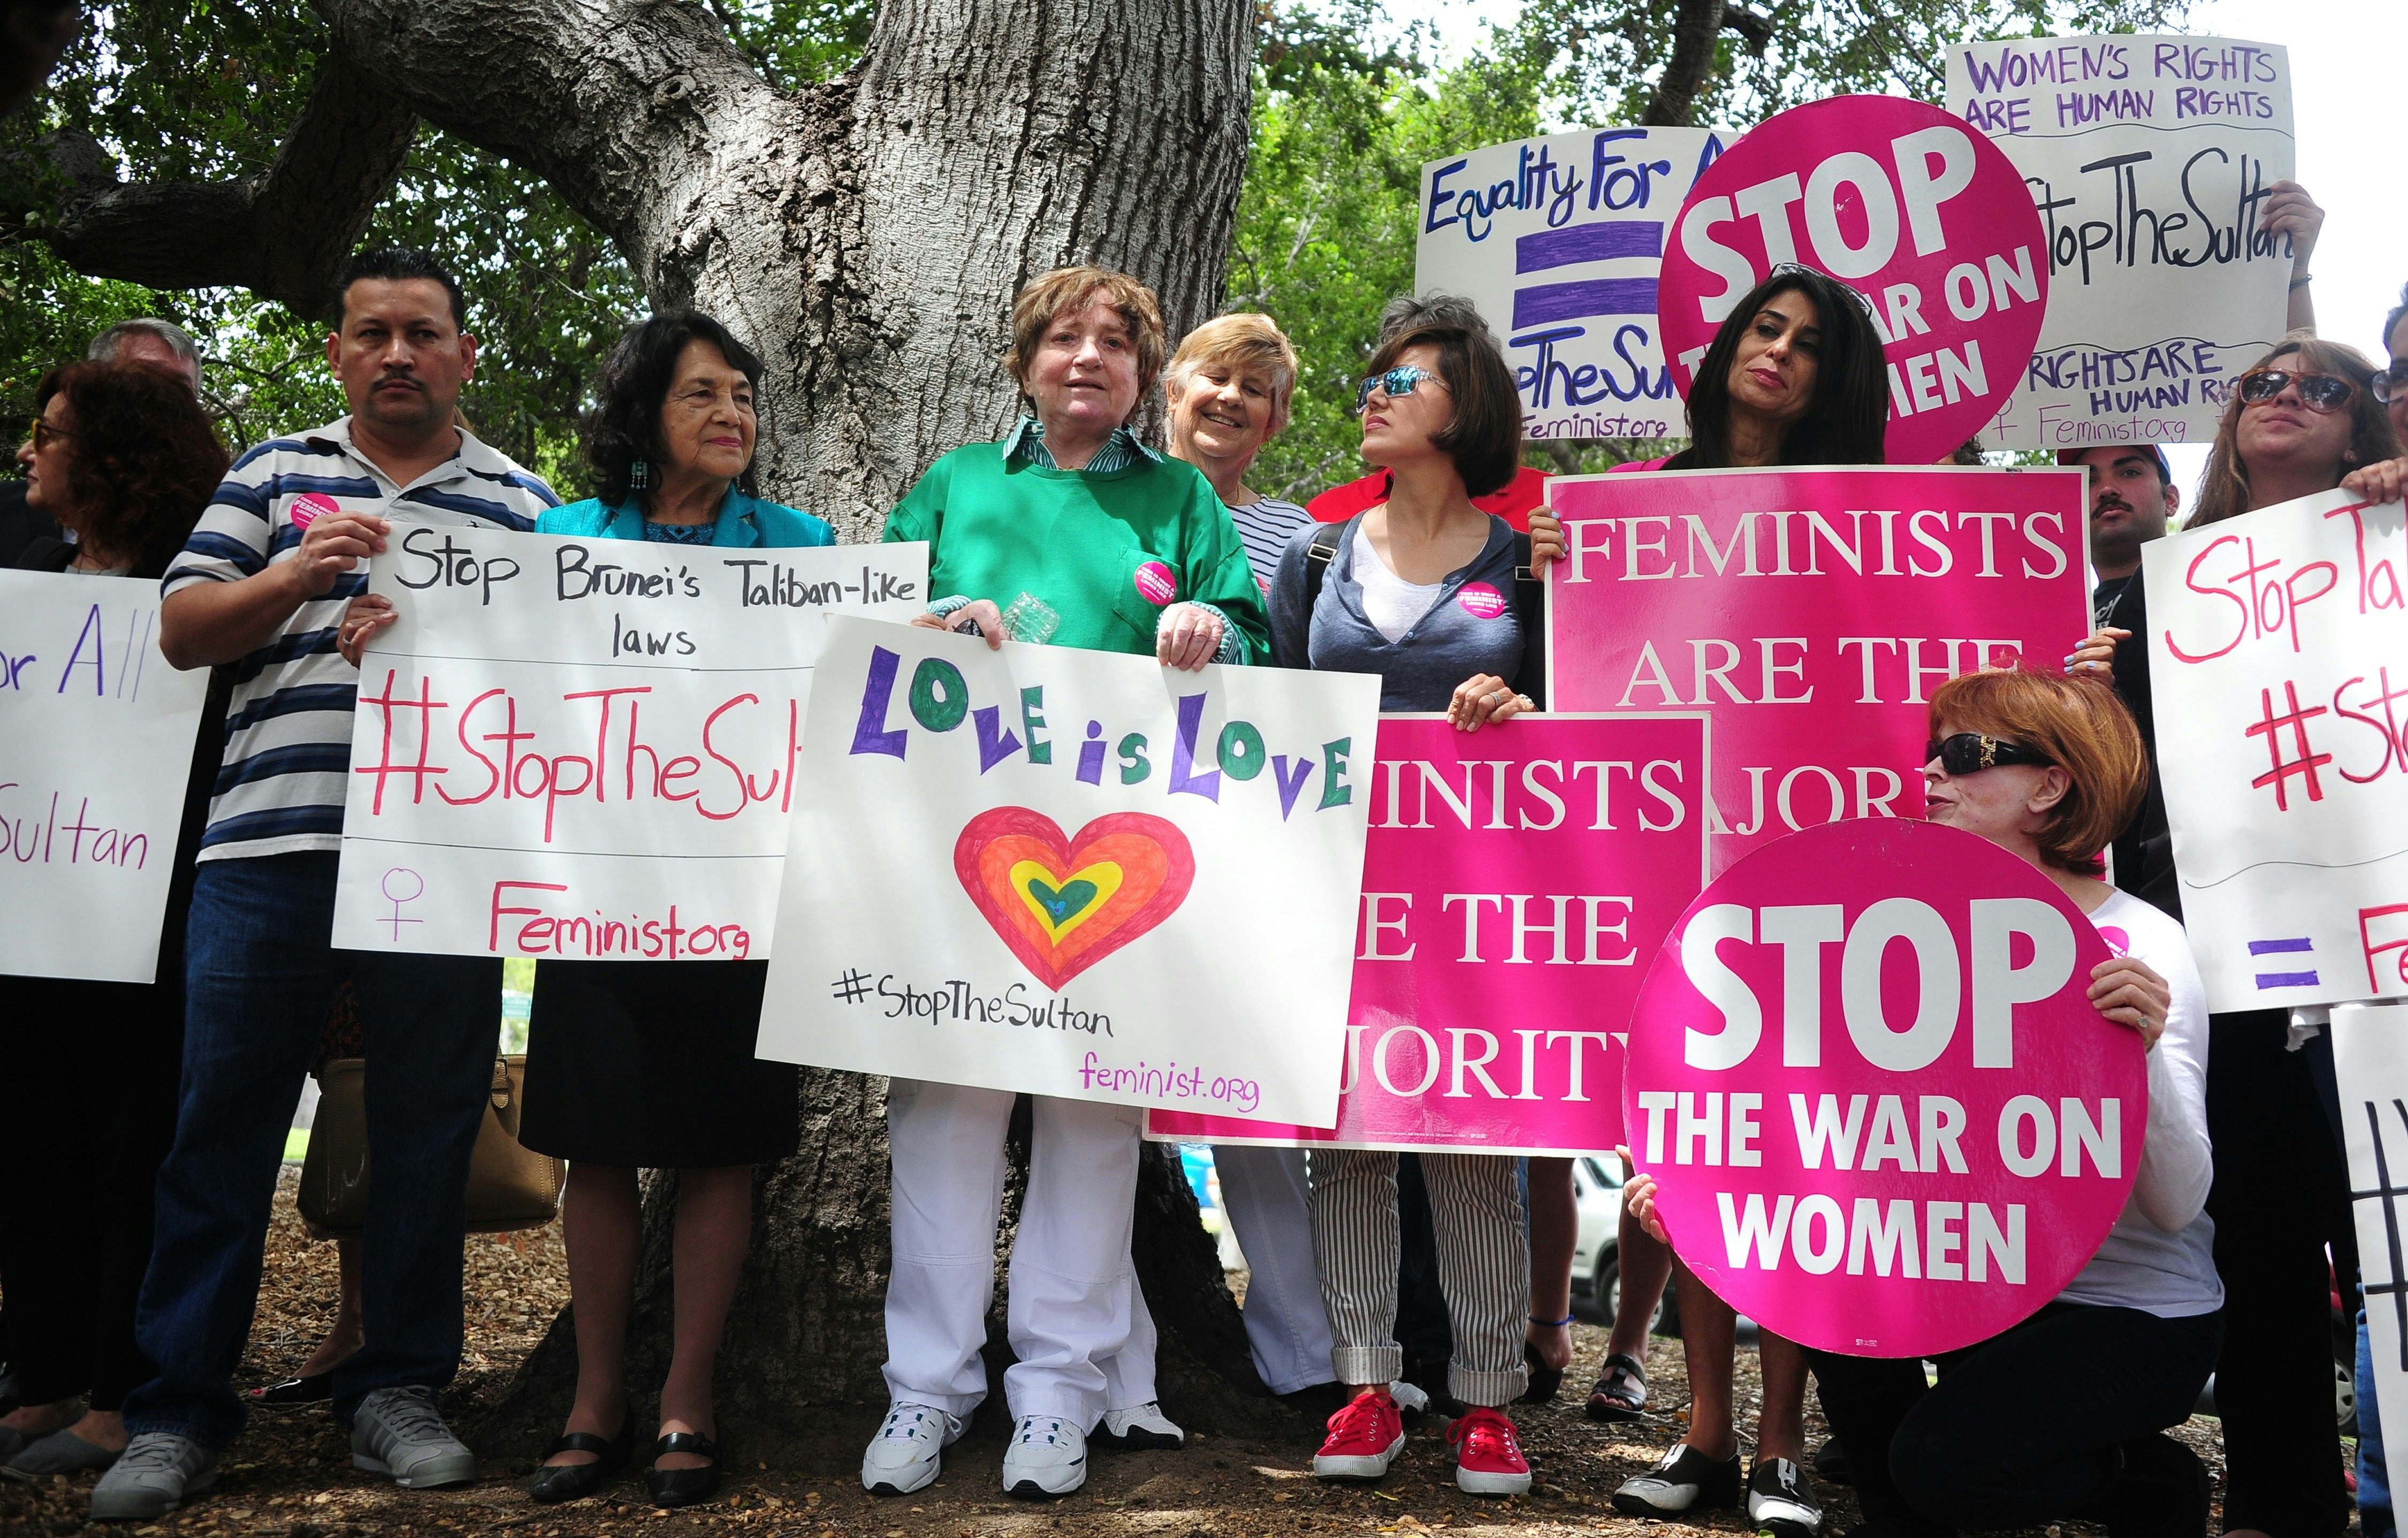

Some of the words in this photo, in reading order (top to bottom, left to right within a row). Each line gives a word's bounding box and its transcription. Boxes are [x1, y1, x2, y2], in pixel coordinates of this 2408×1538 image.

[1964, 43, 2129, 94] WOMEN'S
[2154, 43, 2276, 83] RIGHTS
[1965, 98, 2030, 133] ARE
[2056, 89, 2154, 128] HUMAN
[2176, 86, 2273, 119] RIGHTS
[1424, 143, 1584, 242] Equality
[1588, 128, 1671, 211] For
[1681, 126, 1976, 323] STOP
[1945, 245, 2040, 322] ON
[2028, 351, 2139, 391] RIGHTS
[2140, 341, 2223, 380] ARE
[2090, 378, 2190, 416] HUMAN
[2038, 404, 2186, 444] Feminist.org
[394, 528, 521, 606] Stop
[556, 545, 701, 602] Brunei's
[723, 557, 916, 607] Taliban-like
[1563, 509, 2068, 583] FEMINISTS
[1137, 569, 1175, 599] FEMINIST
[1458, 595, 1503, 606] FEMINIST
[2165, 535, 2338, 664] Stop
[58, 603, 155, 703] All
[613, 613, 697, 658] laws
[1615, 637, 1815, 707] ARE
[355, 668, 803, 843] #StopTheSul
[849, 644, 1053, 775] LOVE
[1075, 719, 1152, 786] is
[1168, 690, 1353, 823] LOVE
[1367, 759, 1687, 832] INISTS
[1710, 765, 1926, 835] JOR
[489, 880, 750, 960] Feminist.org
[1442, 893, 1638, 965] THE
[830, 968, 1114, 1037] #StopTheSultan
[1680, 897, 2077, 1071] STOP
[1339, 1025, 1629, 1102] JORIT
[1637, 1091, 1763, 1167] THE
[1788, 1093, 1970, 1174] WAR
[1998, 1094, 2122, 1179] ON
[1716, 1192, 2028, 1285] WOMEN
